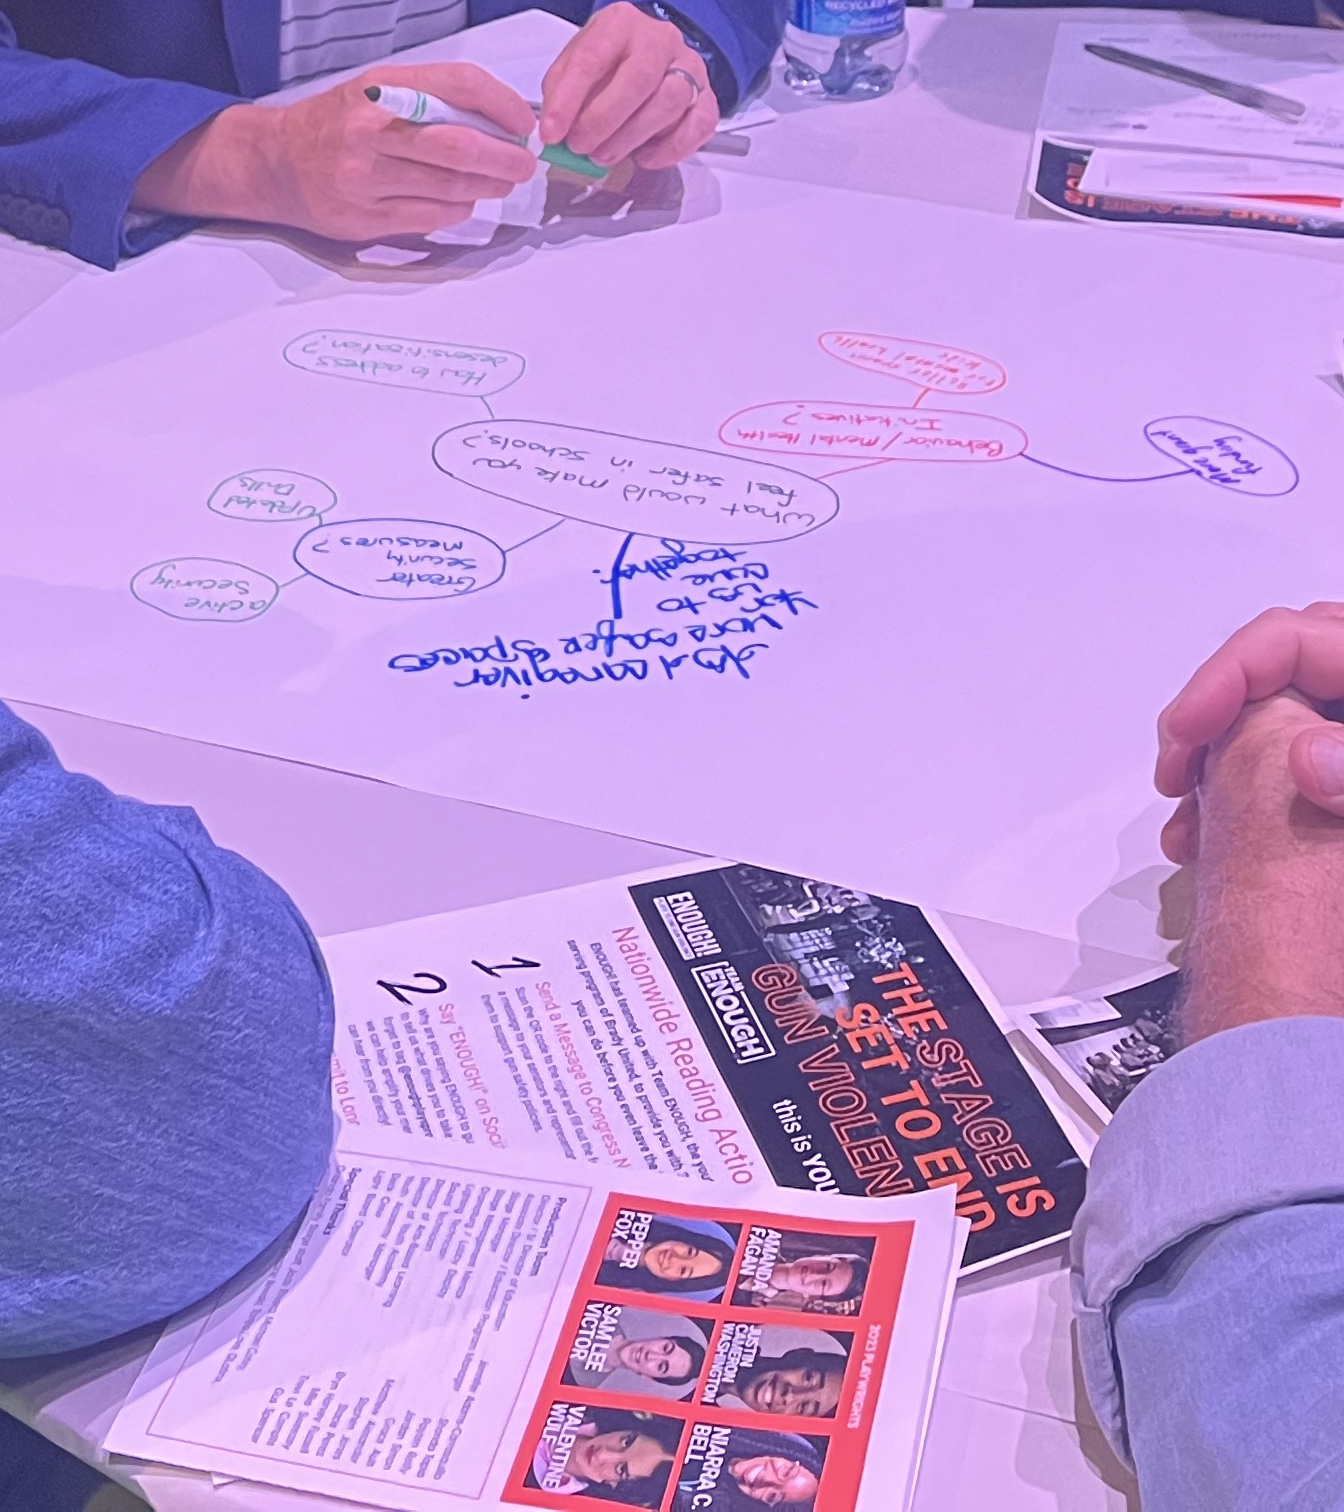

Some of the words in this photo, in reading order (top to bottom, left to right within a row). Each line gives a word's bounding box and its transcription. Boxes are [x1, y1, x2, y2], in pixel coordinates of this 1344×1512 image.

[411, 366, 428, 378] to
[440, 368, 486, 385] How
[472, 456, 521, 471] you
[609, 456, 633, 469] in
[648, 466, 724, 489] safer
[622, 483, 705, 506] would
[746, 480, 796, 506] feel
[719, 502, 814, 527] What
[375, 571, 475, 592] Greater
[657, 595, 705, 615] to
[453, 658, 647, 699] caregiver
[666, 892, 722, 958] ENOUGH!
[471, 956, 542, 978] 1
[724, 966, 745, 992] TEAM
[376, 972, 448, 1006] 2
[535, 981, 562, 1012] Send
[579, 970, 606, 1007] program
[549, 1013, 562, 1022] a
[599, 1007, 614, 1018] of
[700, 968, 765, 1058] ENOUGH
[604, 1019, 624, 1047] Brady
[438, 1003, 456, 1025] Say
[474, 1098, 491, 1115] on
[553, 1022, 587, 1080] Message
[612, 926, 681, 1035] Nationwide
[666, 1037, 723, 1123] Reading
[708, 1129, 754, 1184] Actio
[609, 980, 624, 998] has
[617, 998, 643, 1034] teamed
[634, 1034, 647, 1048] up
[641, 1049, 658, 1070] with
[651, 1070, 670, 1098] Team
[686, 1143, 701, 1160] the
[751, 963, 829, 1045] GUN
[798, 1044, 913, 1198] VIOLEN
[836, 1003, 910, 1071] SET
[881, 1079, 942, 1139] TO
[578, 1081, 594, 1096] to
[633, 1082, 645, 1094] to
[872, 962, 948, 1037] THE
[916, 1038, 1031, 1177] STAGE
[996, 1176, 1055, 1218] IS
[585, 1096, 622, 1156] Congress
[636, 1094, 663, 1129] provide
[653, 1130, 672, 1149] you
[773, 1099, 801, 1133] this
[791, 1135, 812, 1153] is
[802, 1153, 840, 1195] YOU
[666, 1149, 683, 1172] with
[612, 1209, 636, 1240] FOX
[619, 1212, 653, 1269] PEPPER
[740, 1226, 767, 1276] FAGAN
[751, 1230, 783, 1291] AMANDA
[570, 1303, 604, 1360] VICTOR
[598, 1305, 622, 1339] SAM
[865, 1324, 881, 1353] 2023
[585, 1340, 614, 1373] LEE
[706, 1322, 736, 1404] WASHINGTON
[730, 1324, 751, 1384] CAMERON
[740, 1325, 762, 1368] JUSTIN
[847, 1354, 875, 1430] PLAYWRIGHTS
[543, 1404, 570, 1445] WULF
[543, 1406, 587, 1489] VALENTINE
[685, 1423, 712, 1465] BELL
[700, 1426, 732, 1490] NIARRA
[691, 1492, 713, 1511] C.
